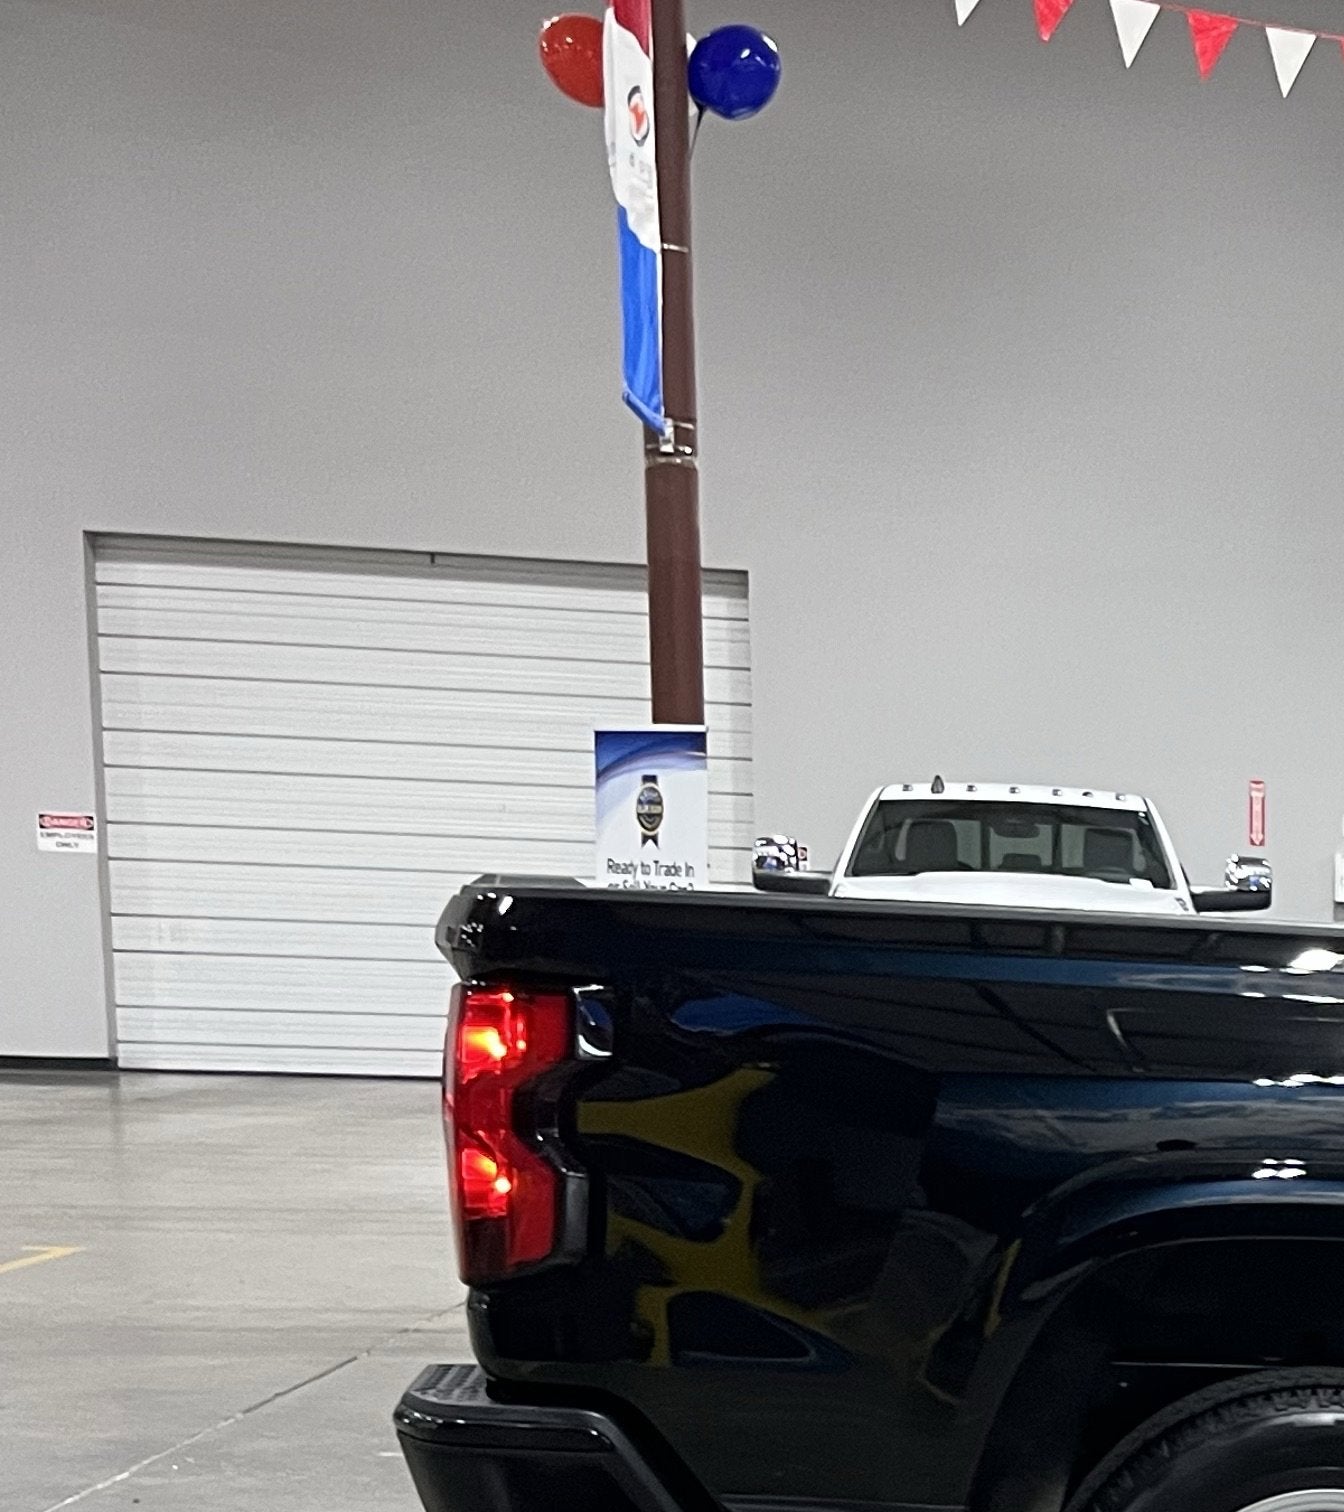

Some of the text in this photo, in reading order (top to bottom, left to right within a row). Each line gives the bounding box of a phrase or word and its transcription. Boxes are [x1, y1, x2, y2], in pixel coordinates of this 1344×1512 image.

[607, 858, 695, 879] Ready to Trade In
